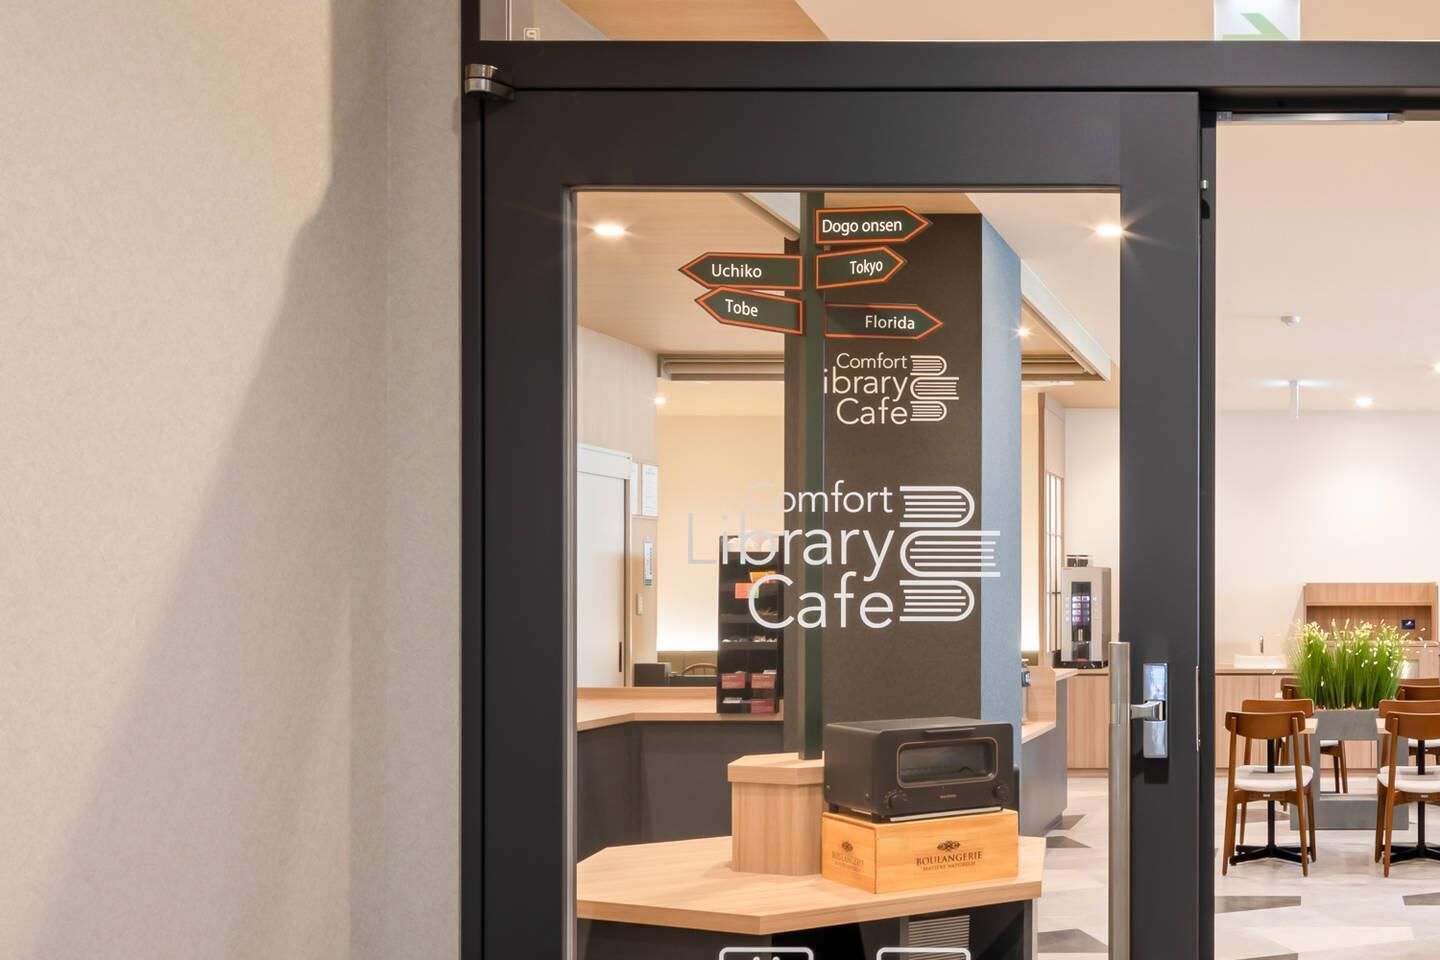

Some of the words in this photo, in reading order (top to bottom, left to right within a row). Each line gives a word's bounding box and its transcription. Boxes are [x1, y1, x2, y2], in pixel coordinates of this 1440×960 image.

[821, 219, 859, 236] Dogo
[861, 219, 903, 233] onsen
[711, 263, 763, 279] Uchiko
[849, 259, 884, 277] Tokyo
[724, 298, 759, 317] Tobe
[865, 315, 916, 330] Florida
[836, 352, 908, 369] Comfort
[823, 366, 908, 402] ibrary
[836, 396, 908, 425] Cafe
[748, 479, 893, 513] Comfort
[687, 511, 895, 582] Library
[748, 571, 894, 629] Cafe
[916, 850, 983, 866] BOULANGERIE
